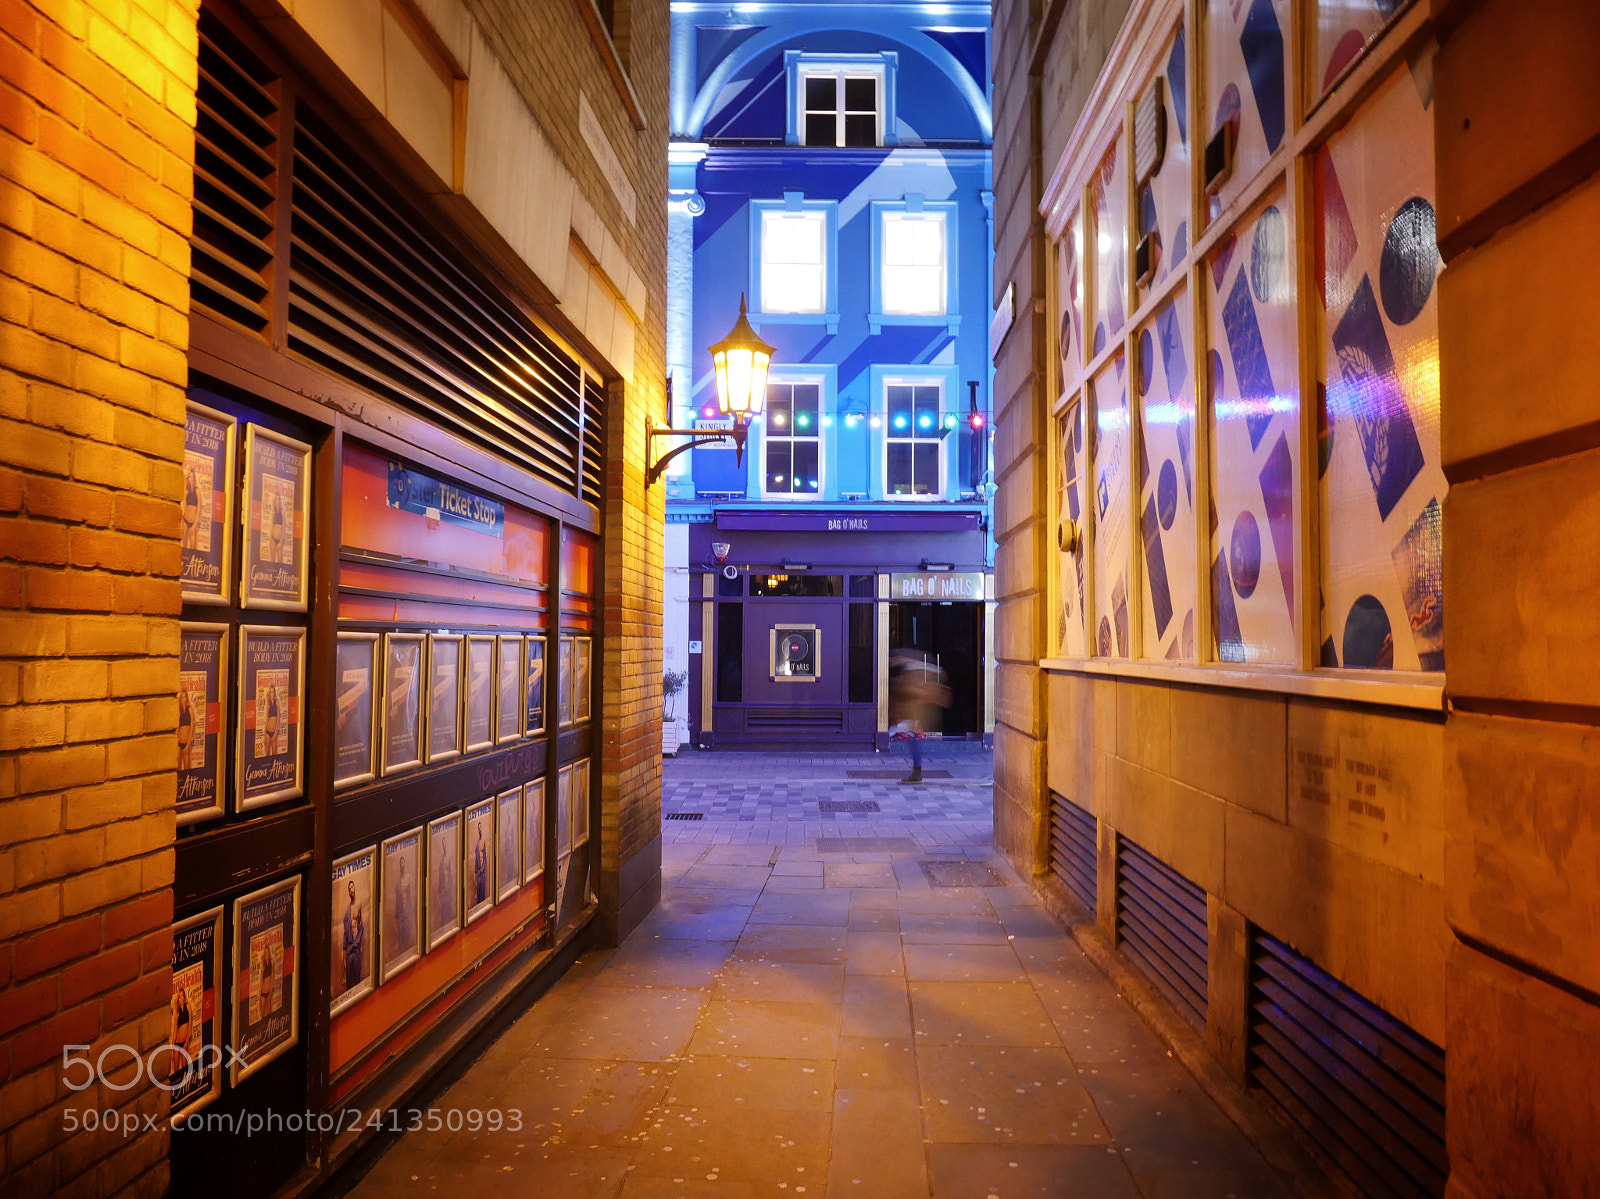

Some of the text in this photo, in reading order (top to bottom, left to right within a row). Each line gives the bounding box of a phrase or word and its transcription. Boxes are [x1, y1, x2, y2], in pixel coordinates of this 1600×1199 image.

[196, 422, 225, 442] FITTER
[439, 482, 472, 518] Ticket
[473, 497, 496, 530] Stop
[828, 518, 841, 530] BAG
[849, 518, 868, 530] NAILS
[902, 577, 924, 597] BAG
[941, 577, 972, 597] NAILS
[189, 640, 218, 652] FITTER
[248, 641, 269, 652] BUILD
[398, 835, 419, 852] TIMES
[332, 854, 371, 882] GAY TIMES
[183, 926, 213, 948] FITTER
[190, 940, 208, 957] 2018
